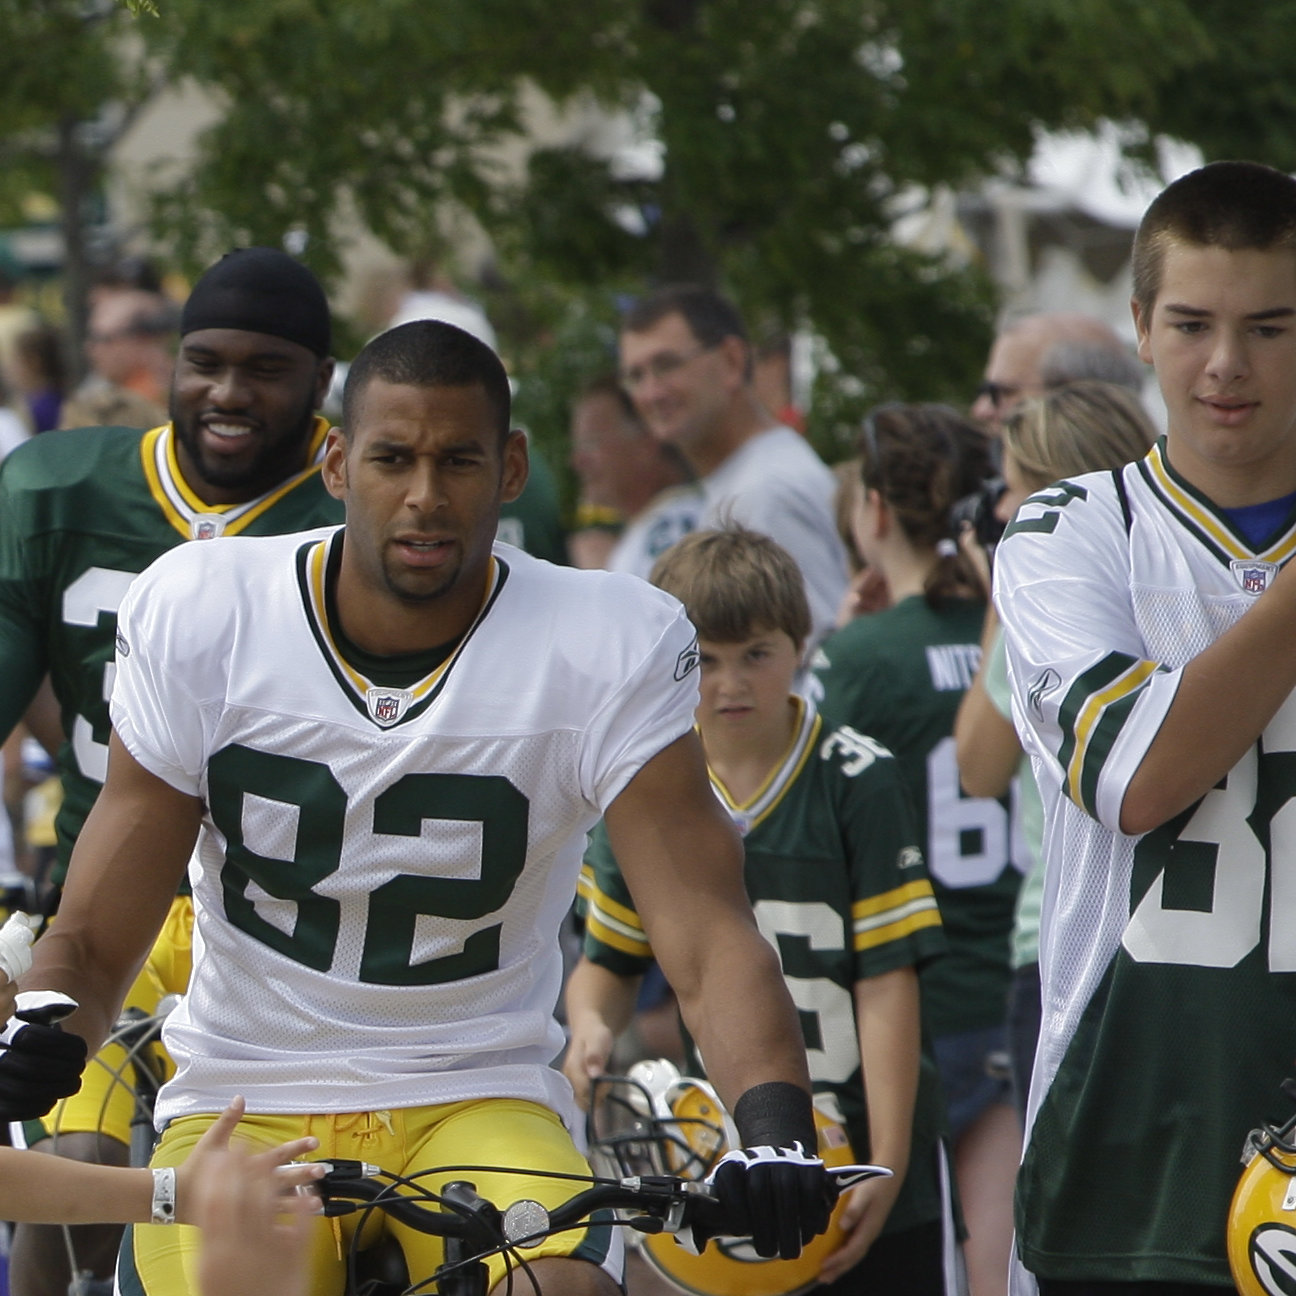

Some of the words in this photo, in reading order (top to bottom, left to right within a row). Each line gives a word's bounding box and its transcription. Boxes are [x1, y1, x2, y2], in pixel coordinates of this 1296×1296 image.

[376, 704, 398, 719] NFL
[208, 742, 530, 987] 82
[927, 736, 1034, 889] 6
[1121, 688, 1296, 974] 8
